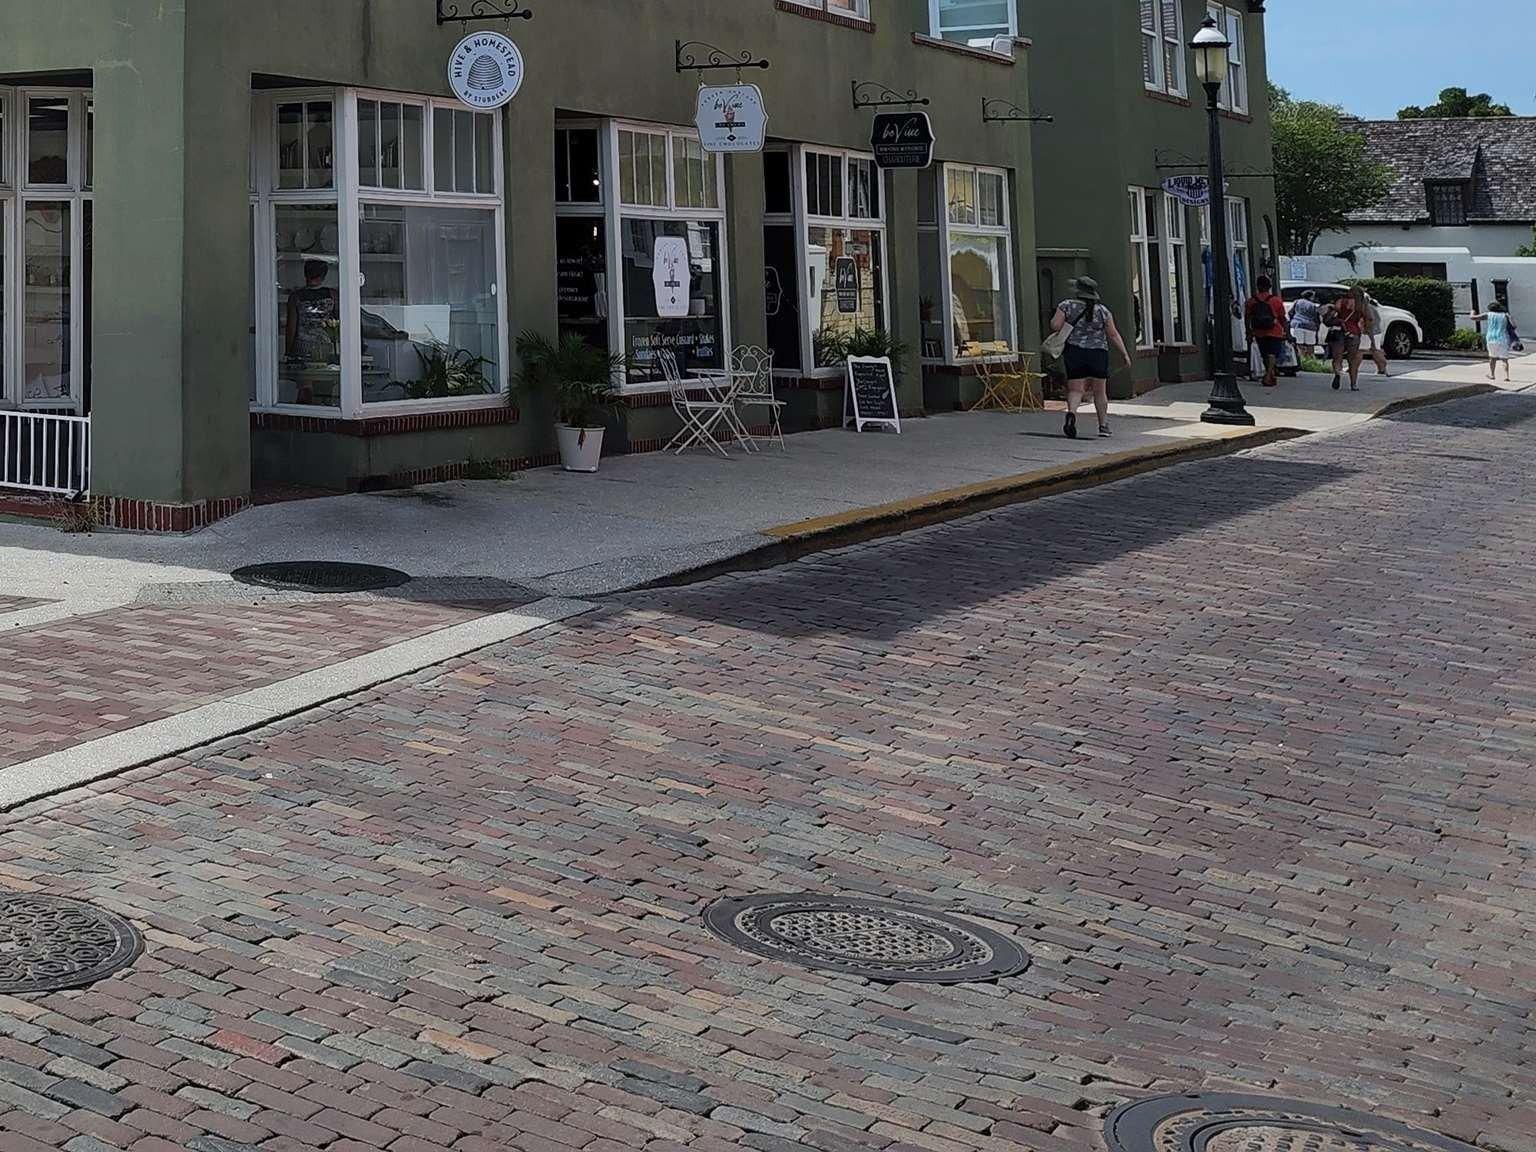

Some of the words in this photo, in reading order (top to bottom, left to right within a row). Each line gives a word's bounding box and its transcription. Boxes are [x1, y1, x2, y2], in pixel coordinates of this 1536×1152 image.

[454, 54, 465, 78] HIVE
[464, 45, 472, 54] &
[474, 38, 516, 77] HOMESTEAD
[464, 90, 472, 99] BY
